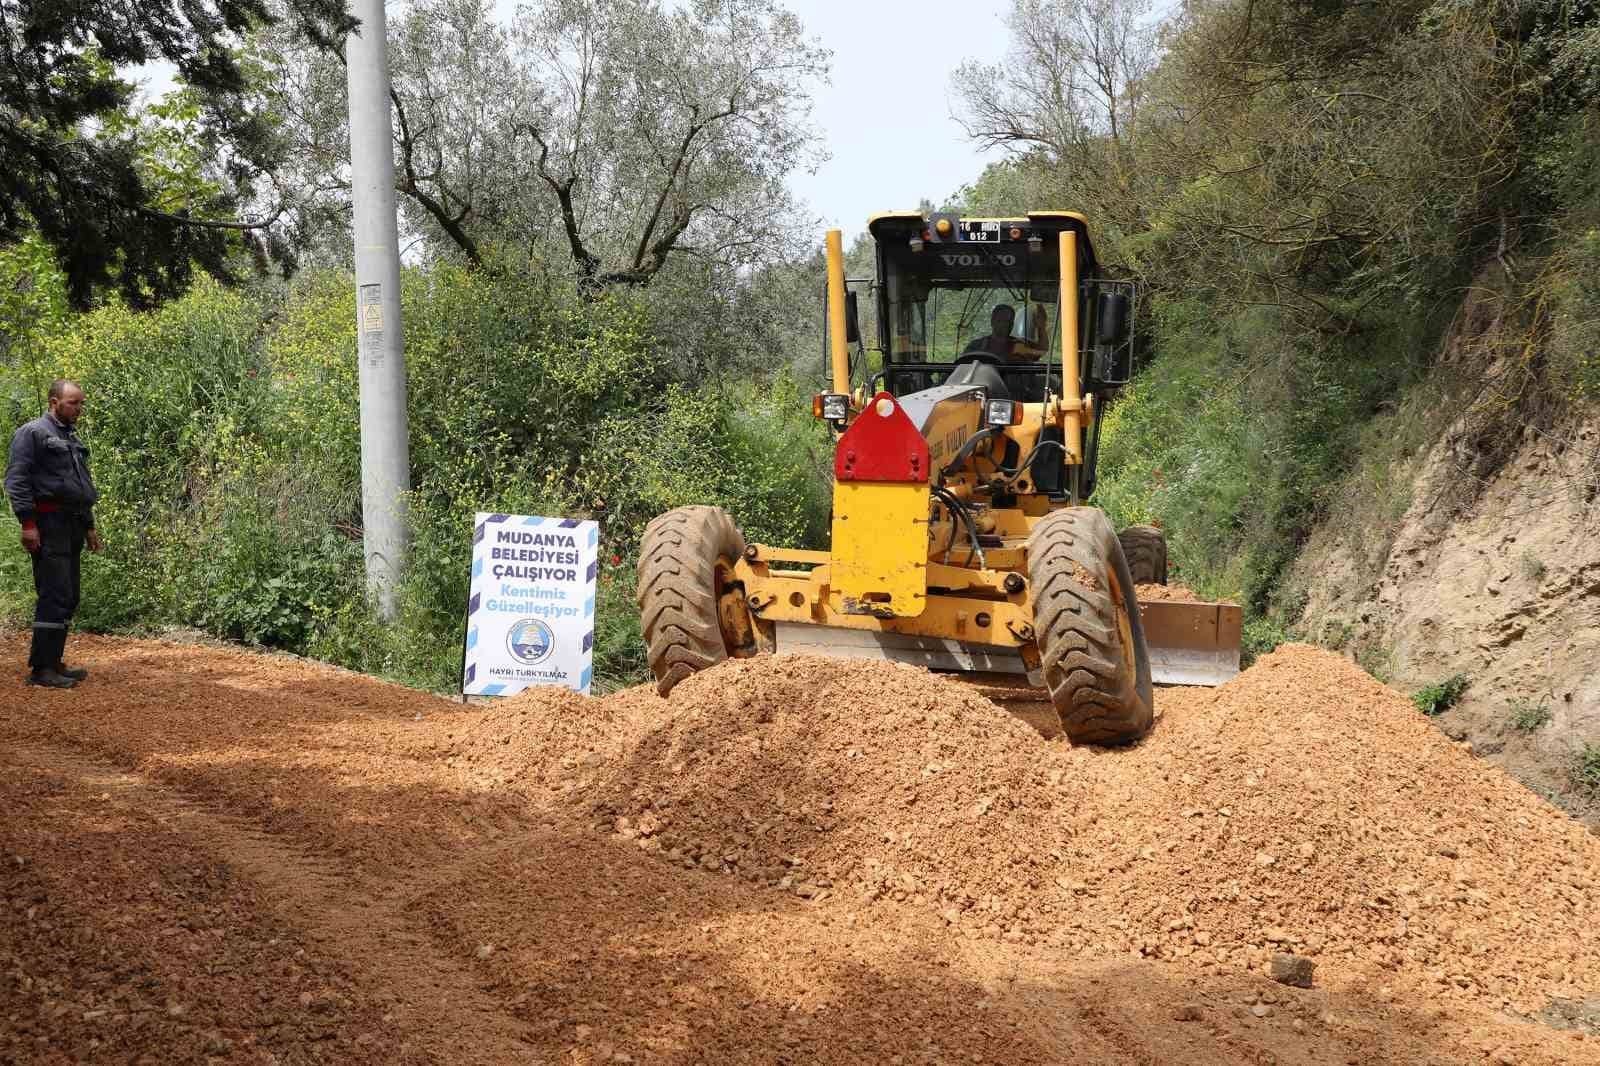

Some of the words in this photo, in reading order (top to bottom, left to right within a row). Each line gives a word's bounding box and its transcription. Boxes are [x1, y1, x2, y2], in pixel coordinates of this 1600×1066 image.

[497, 531, 576, 548] MUDANYA
[491, 547, 579, 565] BELEDİYESİ
[492, 564, 577, 582] ÇALIŞIYOR
[500, 584, 568, 600] Kentimiz
[486, 598, 579, 617] Güzelleşiyor
